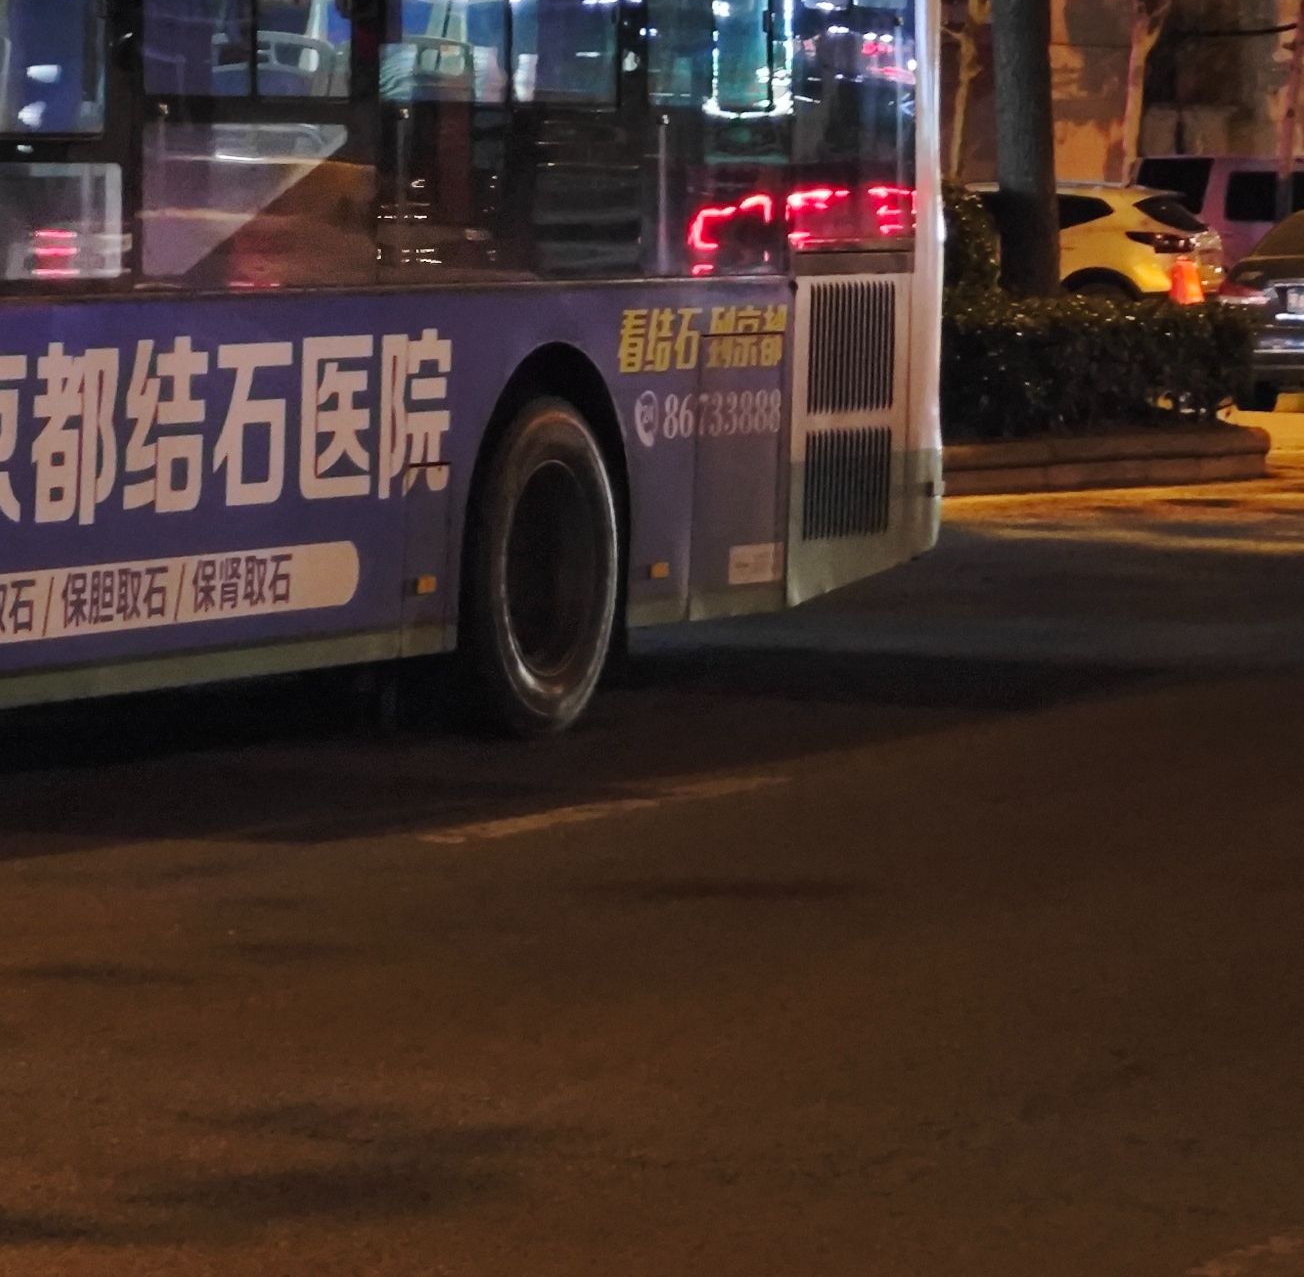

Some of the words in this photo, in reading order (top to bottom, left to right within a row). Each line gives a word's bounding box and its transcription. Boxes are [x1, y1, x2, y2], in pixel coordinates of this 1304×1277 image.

[618, 308, 702, 372] 看结石
[706, 304, 787, 369] 到京都
[61, 566, 169, 626] 保胆取石
[192, 552, 293, 614] 保肾取石
